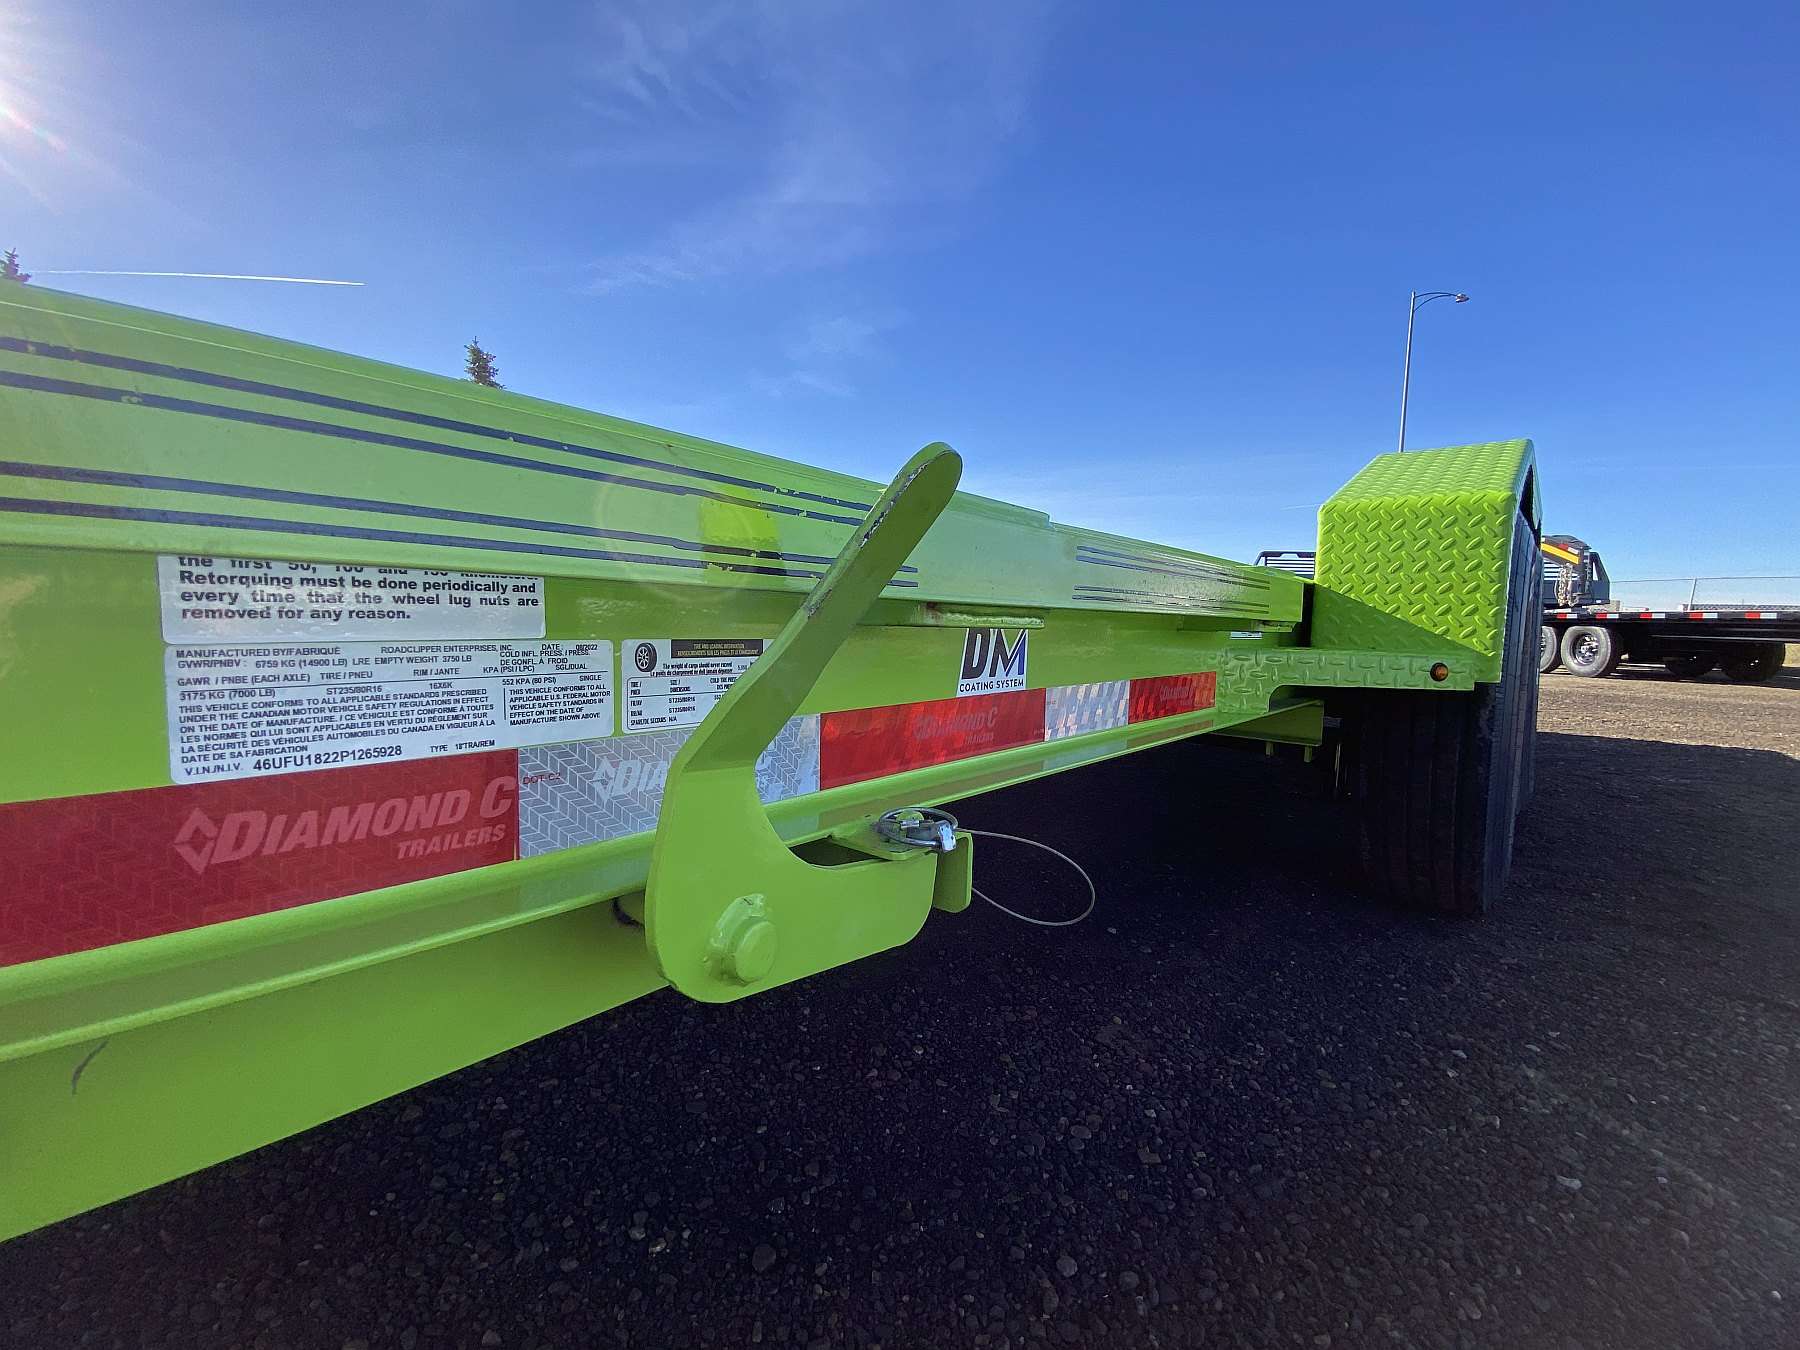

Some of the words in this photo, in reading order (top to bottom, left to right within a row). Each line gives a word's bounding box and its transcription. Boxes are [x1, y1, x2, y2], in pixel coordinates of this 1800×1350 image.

[179, 571, 293, 588] Retorquing
[300, 573, 345, 588] must
[351, 576, 372, 588] be
[378, 577, 417, 589] done
[423, 579, 508, 595] periodically
[512, 583, 536, 593] and
[181, 591, 239, 605] every
[251, 590, 295, 603] time
[306, 590, 345, 604] that
[355, 592, 383, 604] the
[392, 593, 440, 605] wheel
[450, 594, 471, 607] lug
[480, 596, 510, 606] nuts
[517, 598, 539, 606] are
[182, 606, 271, 619] removed
[278, 607, 304, 619] for
[310, 609, 343, 621] any
[348, 609, 411, 619] reason.
[176, 648, 270, 658] MANUFACTURED
[381, 646, 441, 654] ROADCLIPPER
[961, 628, 1026, 679] DM
[255, 661, 278, 669] 6759
[299, 659, 330, 669] (14900
[332, 658, 348, 668] LB)
[352, 657, 370, 666] LRE
[374, 656, 404, 665] EMPTY
[406, 656, 438, 664] WEIGHT
[442, 655, 459, 663] 3750
[177, 677, 210, 687] GAWR
[221, 676, 248, 685] PNBE
[251, 675, 280, 685] (EACH
[282, 673, 310, 683] AXLE)
[320, 672, 341, 680] TIRE
[348, 671, 373, 679] PNEU
[180, 692, 206, 700] 3175
[209, 691, 225, 699] KG
[228, 689, 256, 700] (7000
[258, 688, 275, 698] LB)
[553, 685, 586, 693] CONFORMS
[959, 681, 993, 693] COATING
[996, 679, 1024, 689] SYSTEM
[179, 705, 202, 714] THIS
[206, 703, 248, 712] VEHICLE
[251, 700, 303, 709] CONFORMS
[321, 697, 338, 705] ALL
[340, 694, 392, 703] APPLICABLE
[392, 691, 440, 699] STANDARDS
[442, 688, 487, 697] PRESCRIBED
[509, 695, 549, 703] APPLICABLE
[563, 692, 589, 700] FEDERAL
[179, 714, 216, 724] UNDER
[219, 712, 238, 721] THE
[241, 709, 290, 719] CANADIAN
[292, 707, 326, 716] MOTOR
[328, 705, 363, 713] VEHICLE
[365, 702, 397, 710] SAFETY
[400, 698, 452, 707] REGULATIONS
[453, 697, 460, 705] IN
[462, 696, 489, 704] EFFECT
[180, 725, 195, 734] ON
[199, 724, 219, 732] THE
[221, 722, 248, 731] DATE
[251, 720, 262, 729] OF
[400, 708, 415, 716] EST
[417, 706, 458, 715] CONFORME
[467, 704, 494, 712] TOUTES
[509, 717, 557, 726] MANUFACTURE
[559, 714, 580, 722] SHOWN
[181, 735, 200, 743] LES
[203, 732, 247, 742] NORMES
[250, 730, 266, 738] QUI
[269, 728, 283, 736] LUI
[286, 726, 310, 735] SONT
[313, 721, 372, 732] APPLICABLES
[387, 717, 413, 725] VERTU
[415, 716, 426, 724] DU
[181, 745, 195, 754] LA
[251, 739, 270, 747] DES
[326, 729, 385, 740] AUTOMOBILES
[401, 724, 434, 733] CANADA
[446, 721, 477, 730] VIGUEUR
[181, 754, 210, 764] DATE
[213, 753, 226, 762] DE
[229, 750, 243, 759] SA
[245, 746, 308, 758] FABRICATION
[430, 745, 448, 753] TYPE
[253, 745, 402, 771] 46UFU1822P1265928
[210, 789, 472, 864] DIAMOND
[479, 776, 515, 818] C
[397, 823, 506, 860] TRAILERS
